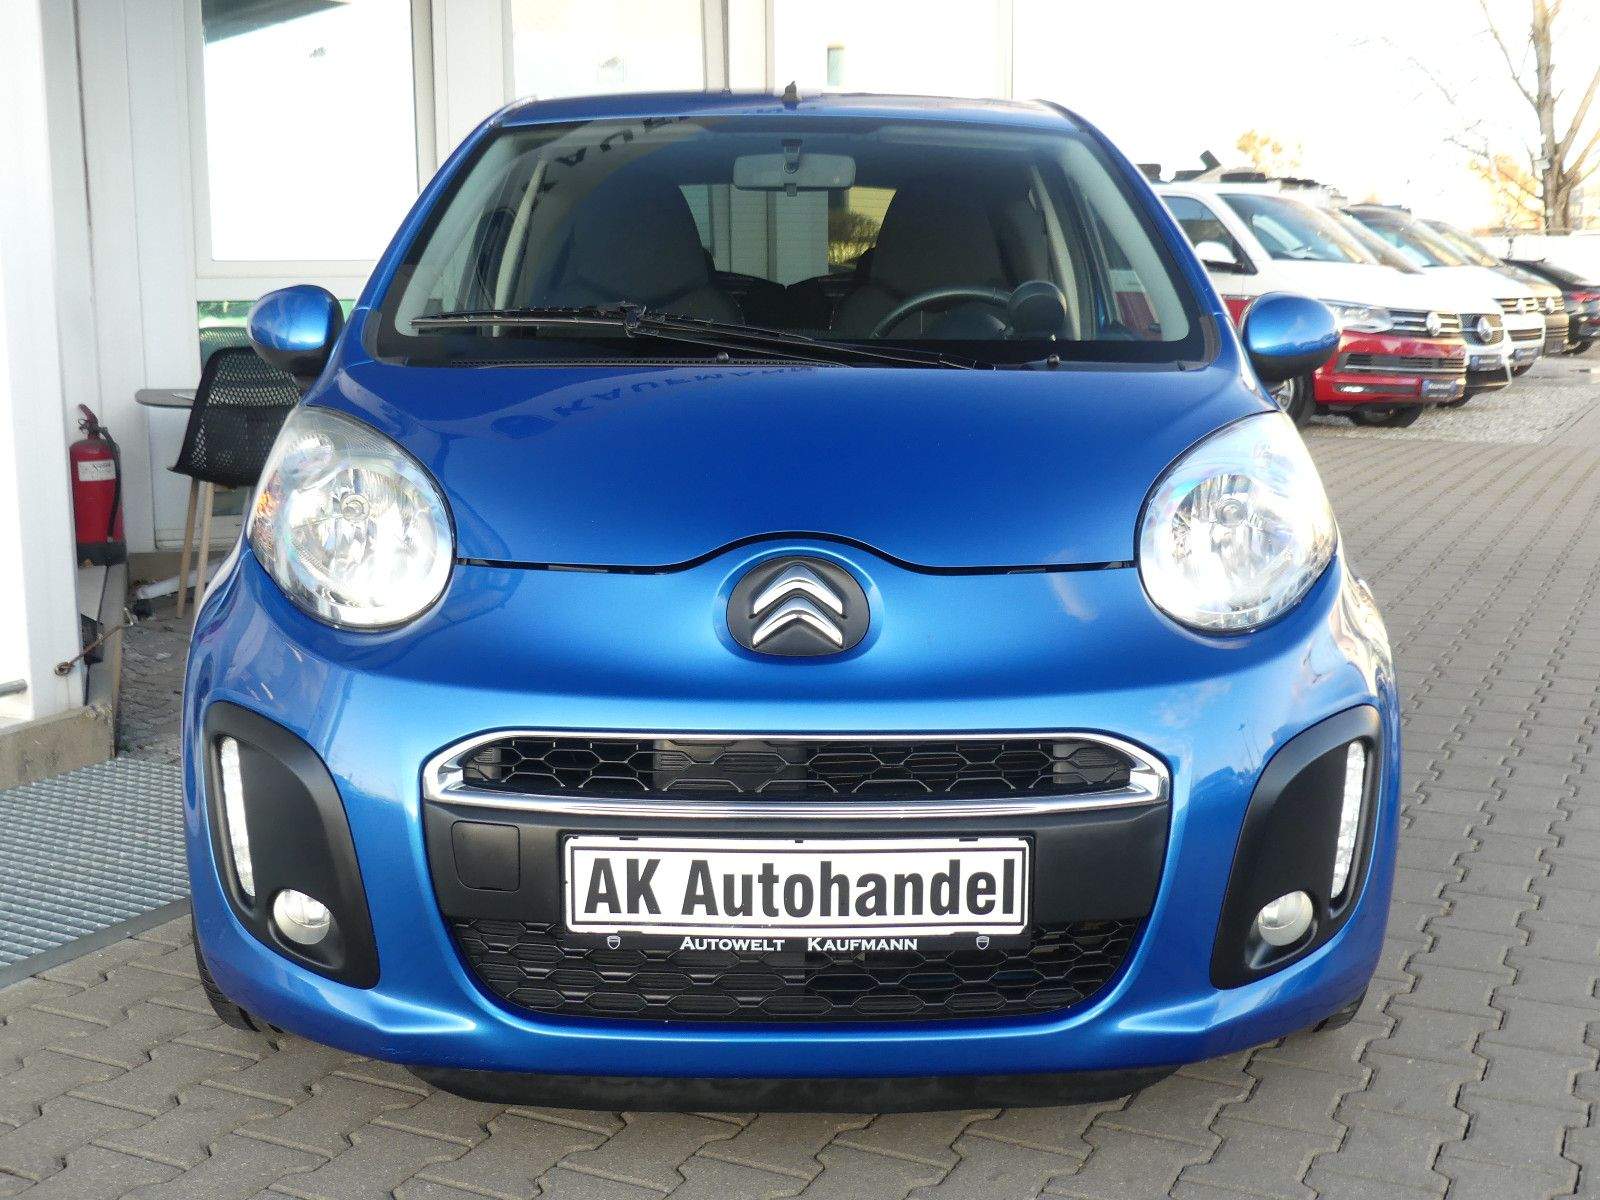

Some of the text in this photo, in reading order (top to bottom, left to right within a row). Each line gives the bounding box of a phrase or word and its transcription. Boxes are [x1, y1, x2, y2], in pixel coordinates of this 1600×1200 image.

[584, 857, 1015, 918] AK Autohandel
[680, 936, 918, 951] AUTOWELT KAUFMANN
